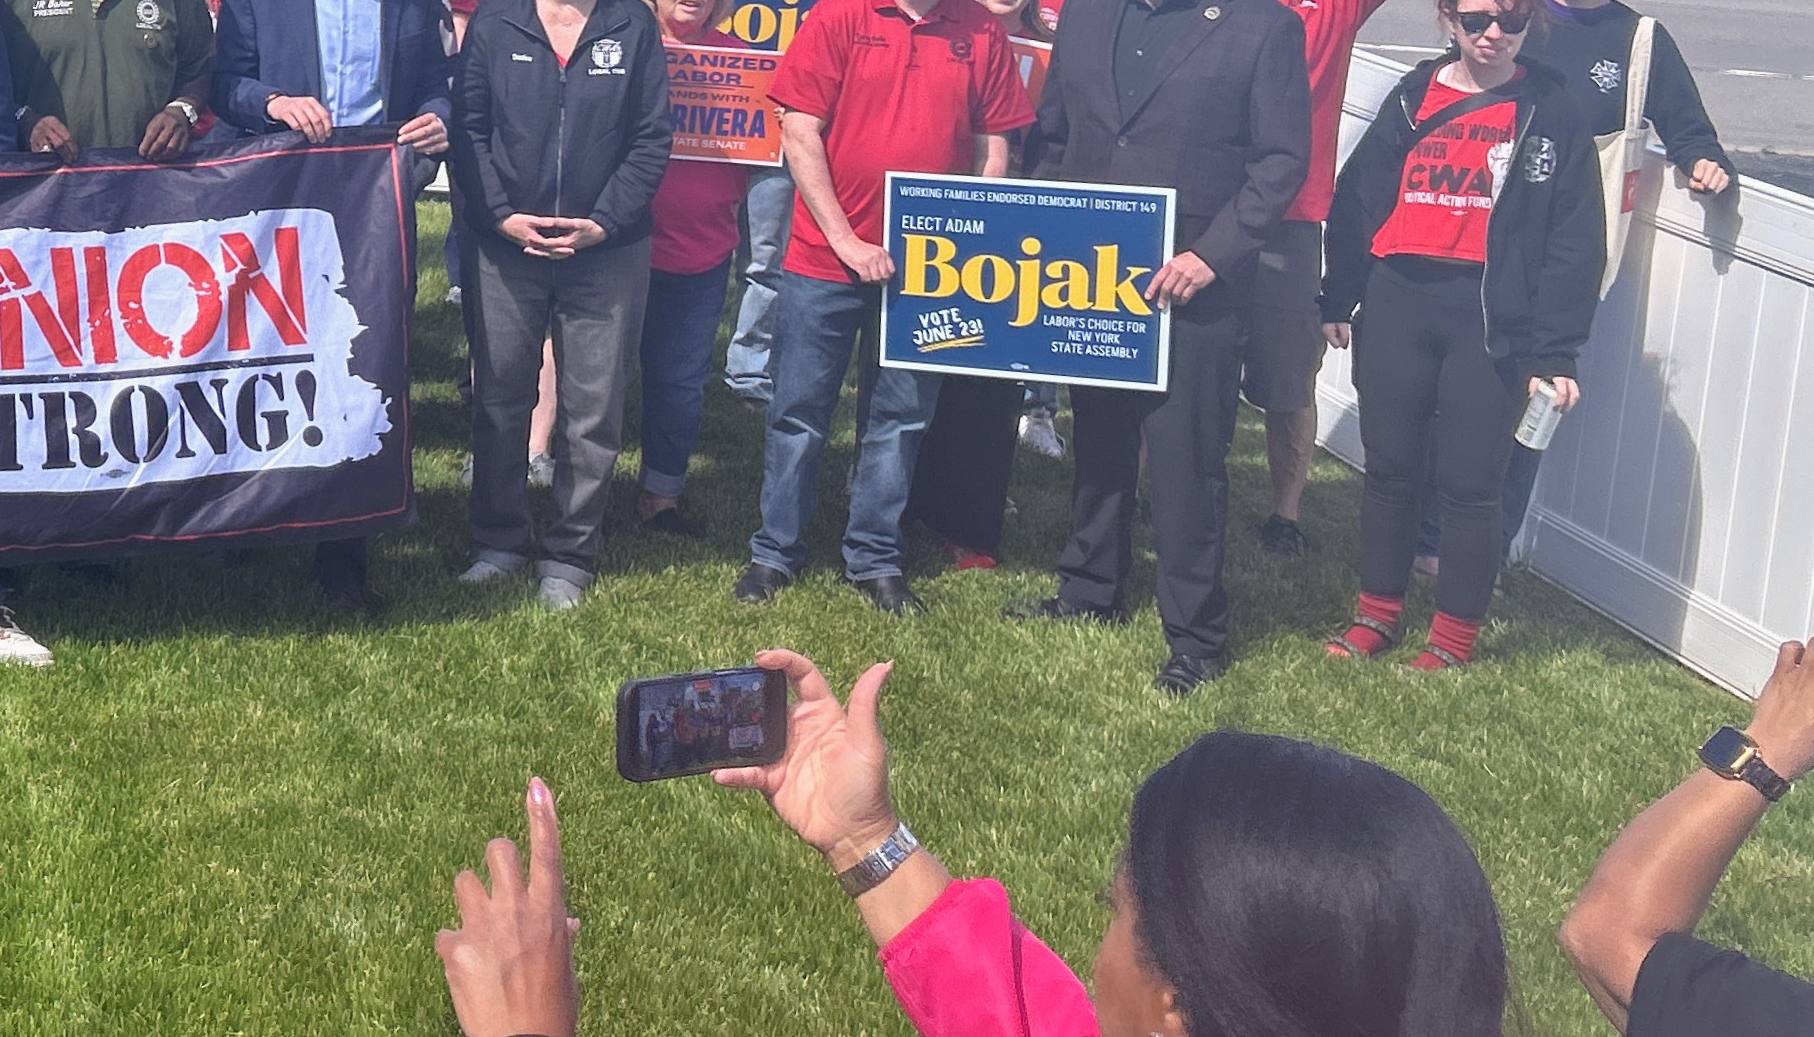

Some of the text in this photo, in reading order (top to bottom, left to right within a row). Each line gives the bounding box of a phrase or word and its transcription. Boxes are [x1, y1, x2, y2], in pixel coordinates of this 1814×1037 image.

[711, 93, 749, 103] WITH
[701, 139, 746, 150] SENATE
[1407, 164, 1492, 197] CWA
[900, 186, 1157, 213] WORKING FAMILIES ENDORSED DEMOCRAT DISTRICT 149
[1437, 194, 1491, 208] ACTION FUND
[902, 215, 984, 234] ELECT ADAM
[900, 234, 1153, 326] Bojak
[918, 307, 961, 328] VOTE
[1043, 315, 1146, 334] LABOR'S CHOICE FOR
[913, 319, 984, 345] JUNE 23!
[1068, 330, 1120, 345] NEW YORK
[1052, 342, 1139, 359] STATE ASSEMBLY
